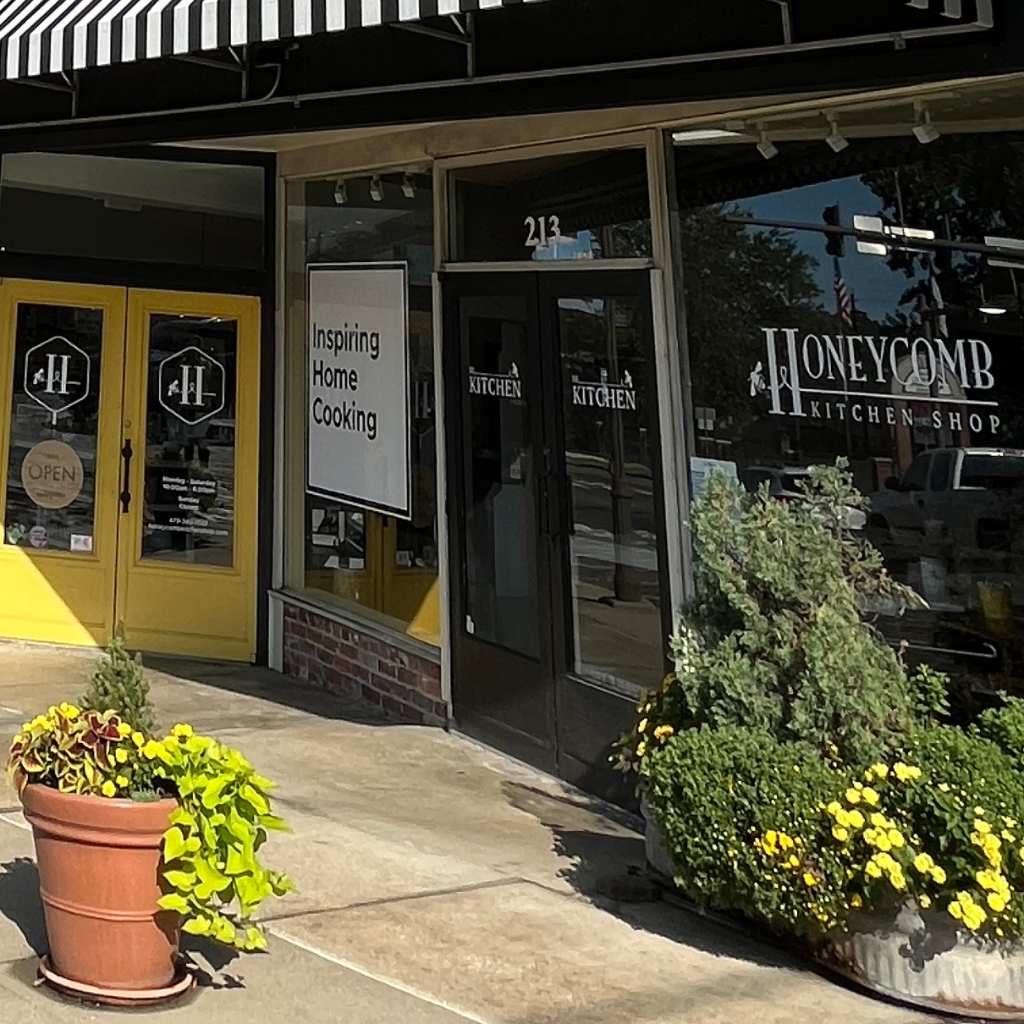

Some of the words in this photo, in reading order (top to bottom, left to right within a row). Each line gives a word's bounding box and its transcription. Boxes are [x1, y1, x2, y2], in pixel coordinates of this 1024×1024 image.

[524, 215, 561, 246] 213
[312, 322, 380, 360] Inspiring
[312, 359, 358, 391] Home
[468, 376, 522, 399] KITCHEN
[761, 327, 995, 417] HONEYCOMB
[572, 385, 637, 410] KITCHEN
[312, 397, 377, 440] Cooking
[810, 400, 914, 427] KITCHEN
[932, 410, 1001, 434] SHOP
[28, 463, 76, 482] OPEN
